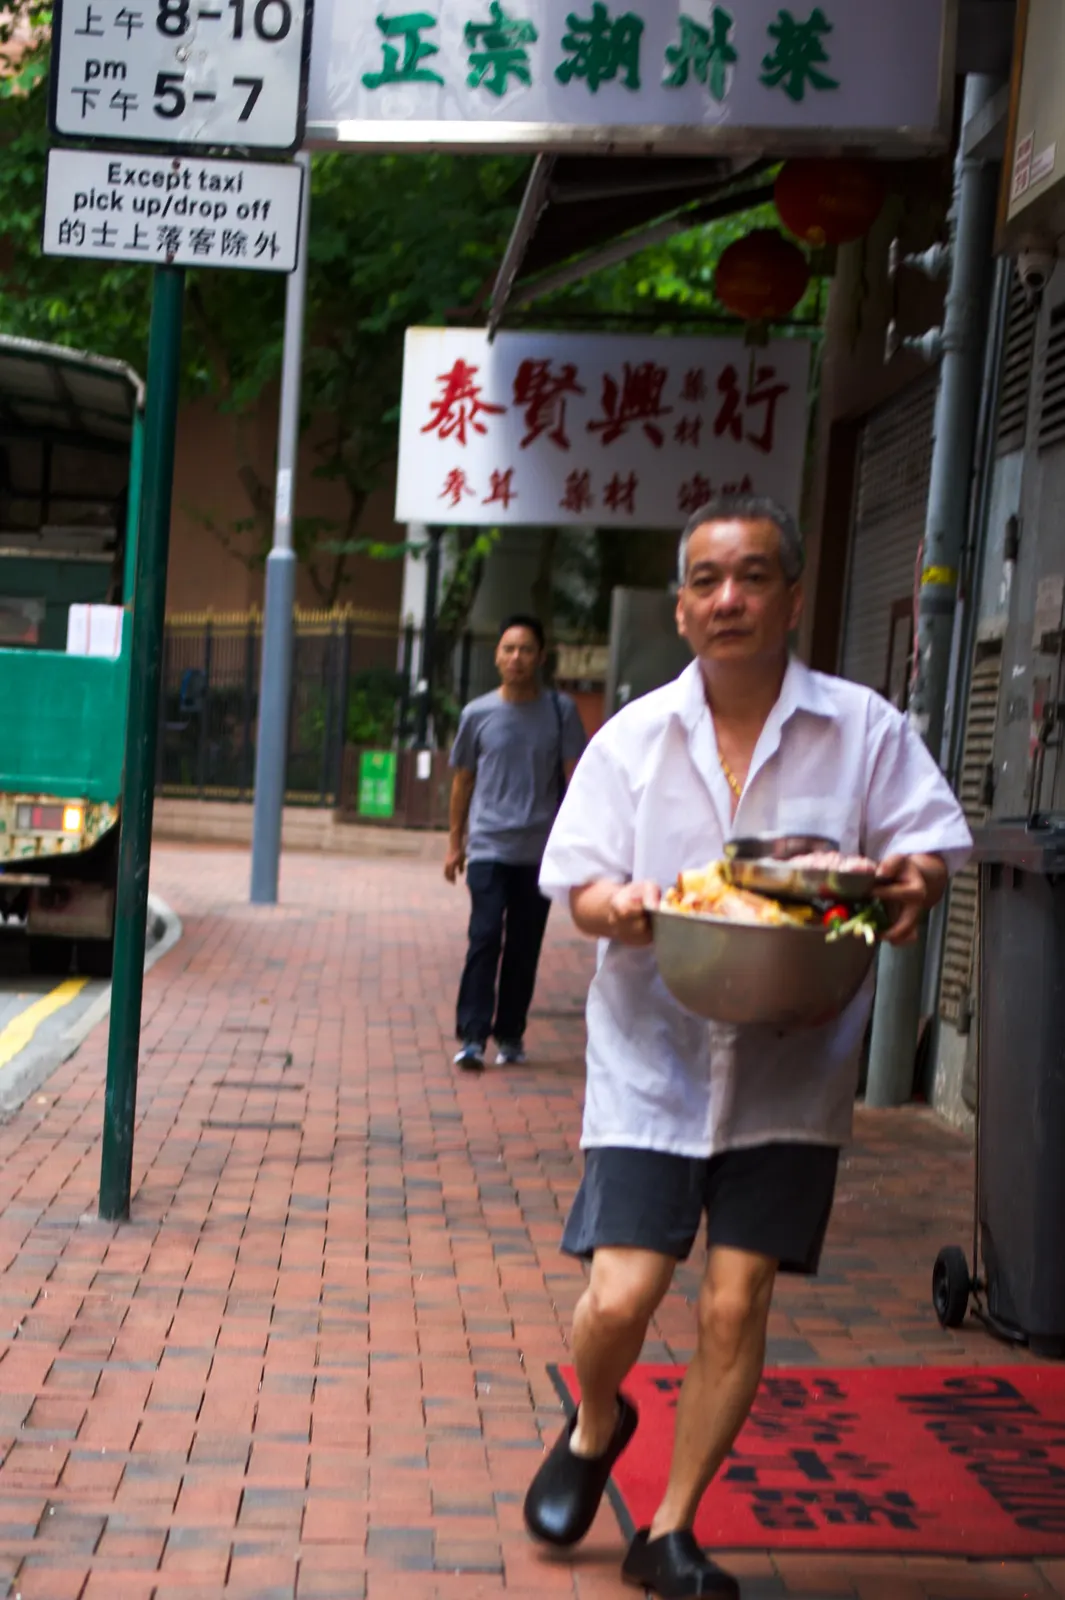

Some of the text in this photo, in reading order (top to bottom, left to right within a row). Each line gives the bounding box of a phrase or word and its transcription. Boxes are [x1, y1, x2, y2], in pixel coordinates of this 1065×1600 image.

[74, 5, 144, 40] 上午
[361, 2, 841, 102] 正宗潮州菜
[85, 58, 128, 82] pm
[71, 87, 139, 121] 下午
[107, 161, 244, 193] Except taxi
[73, 188, 273, 222] pick up/drop off
[58, 218, 281, 261] 的士上落客除外
